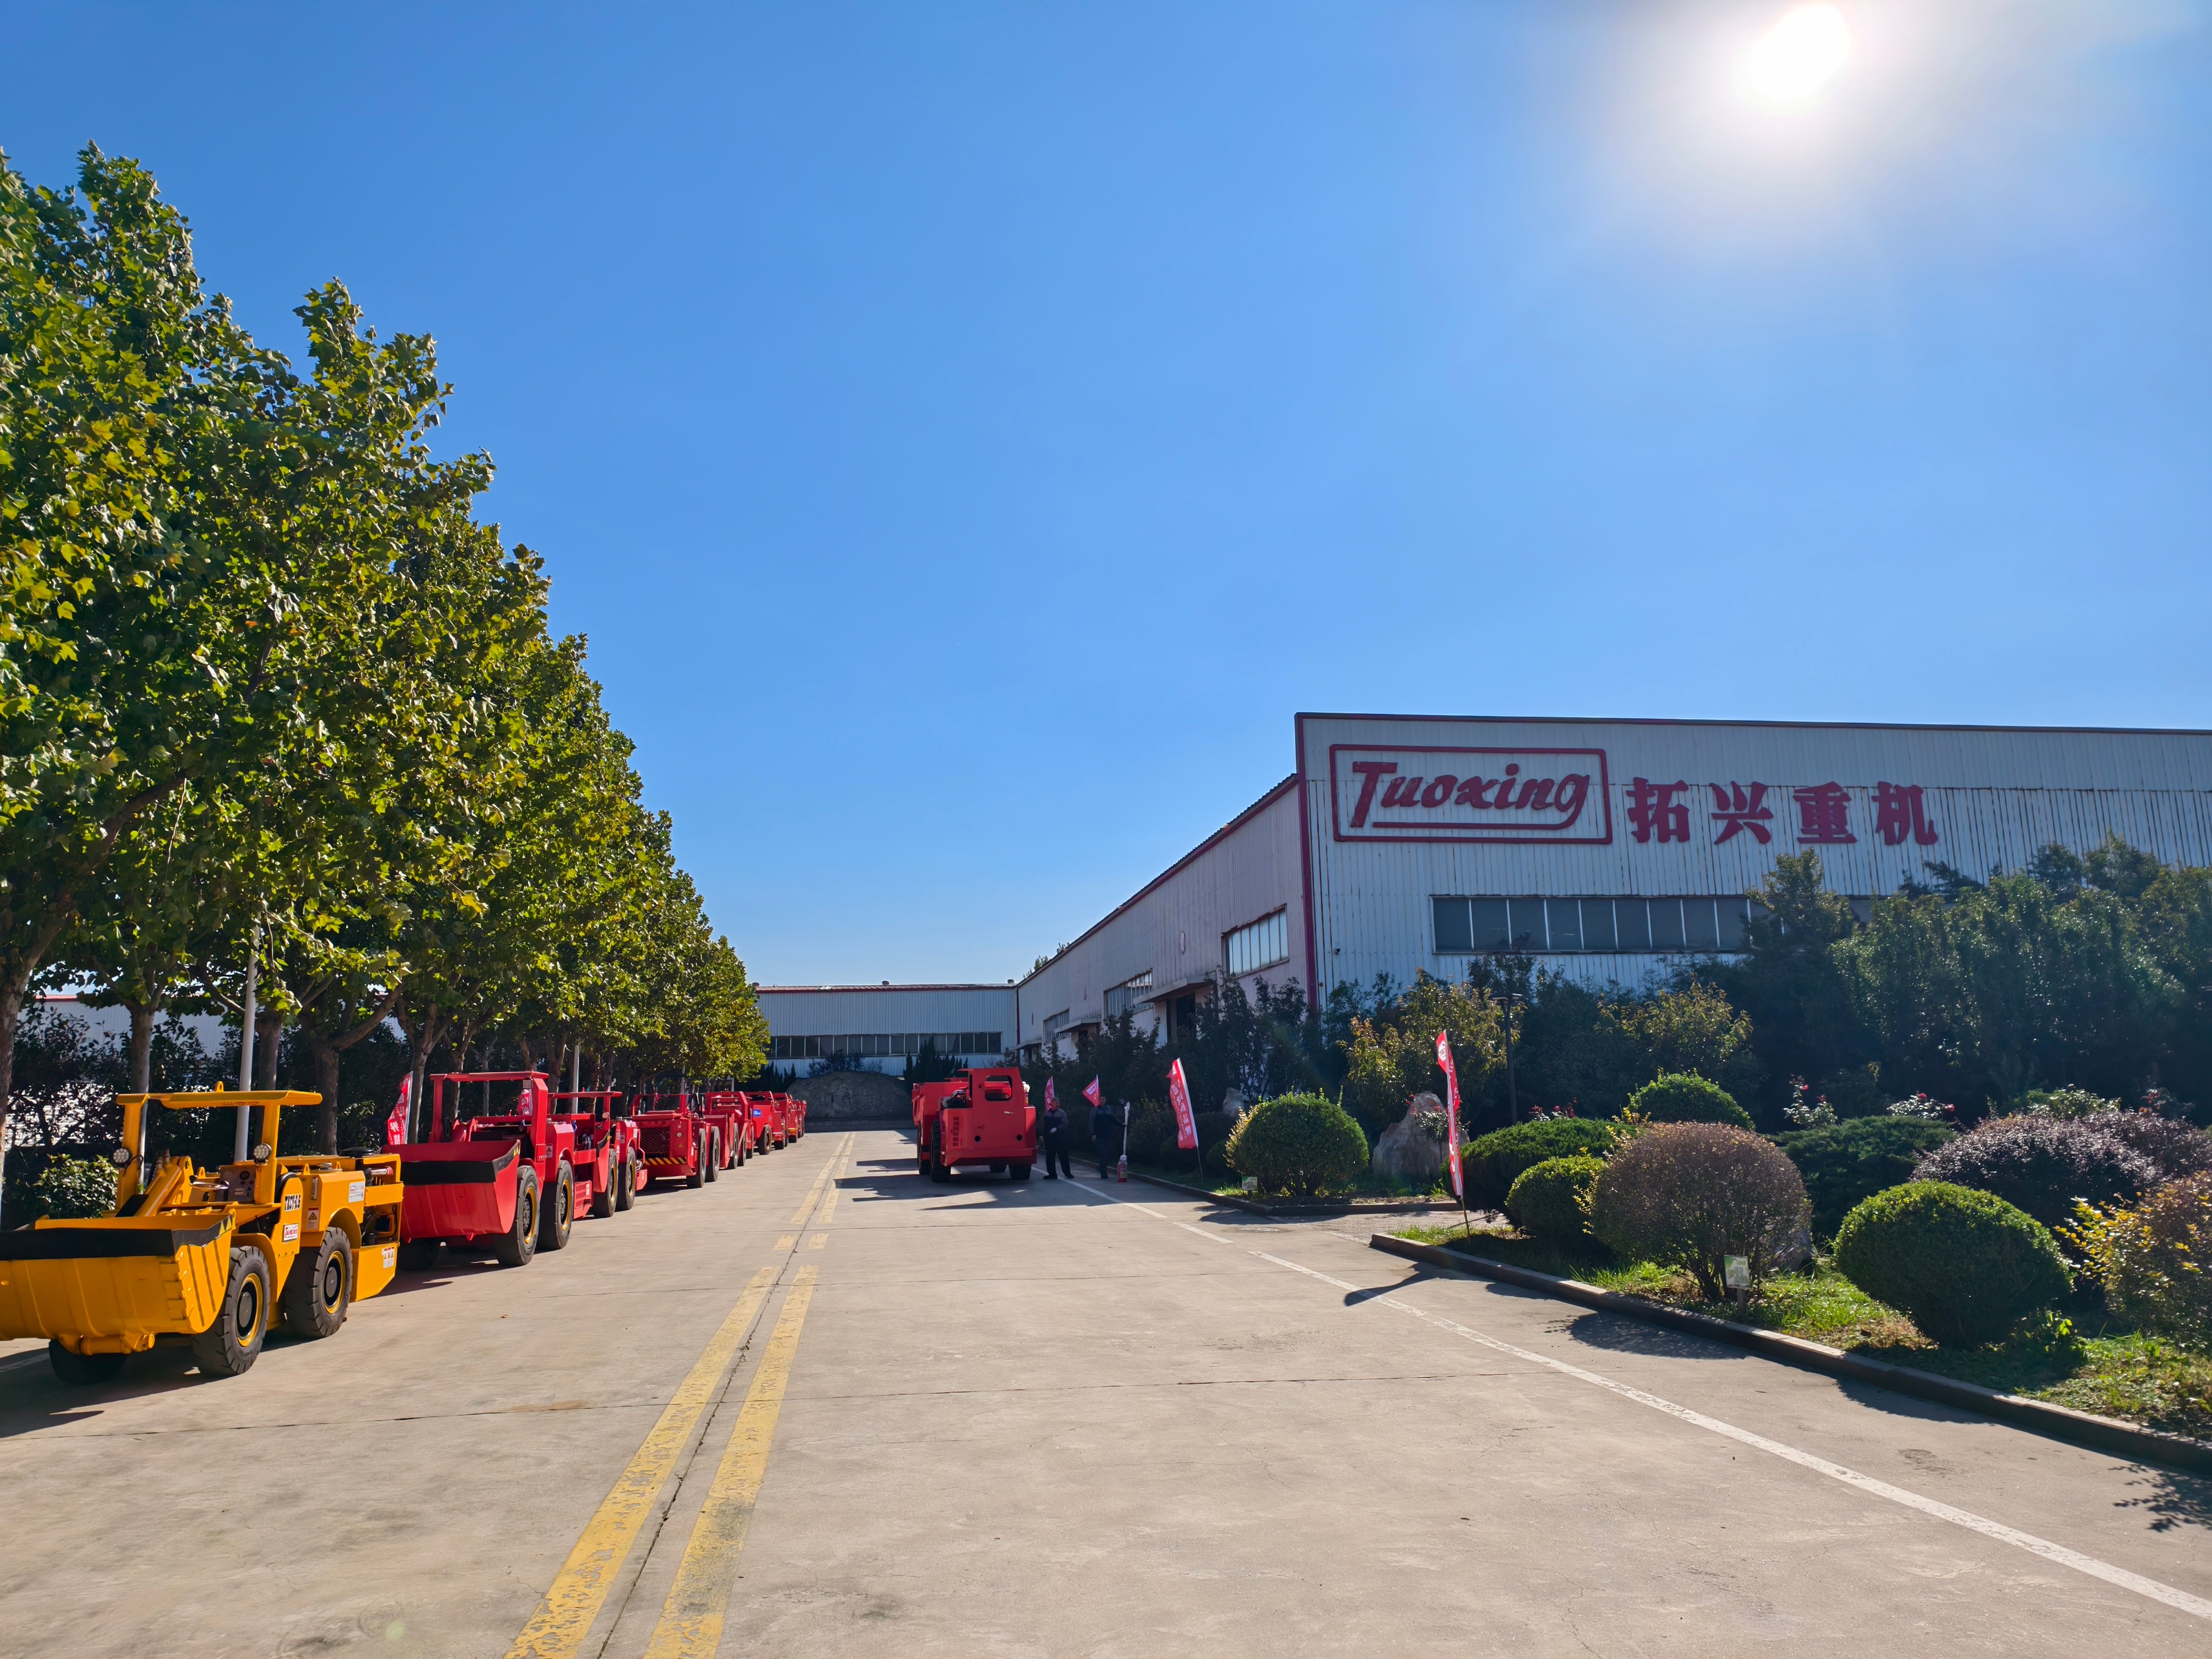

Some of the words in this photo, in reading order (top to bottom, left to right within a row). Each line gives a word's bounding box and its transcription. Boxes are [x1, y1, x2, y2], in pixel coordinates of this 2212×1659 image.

[1351, 761, 1590, 830] Tuoxing
[1626, 776, 1938, 846] 拓兴重机
